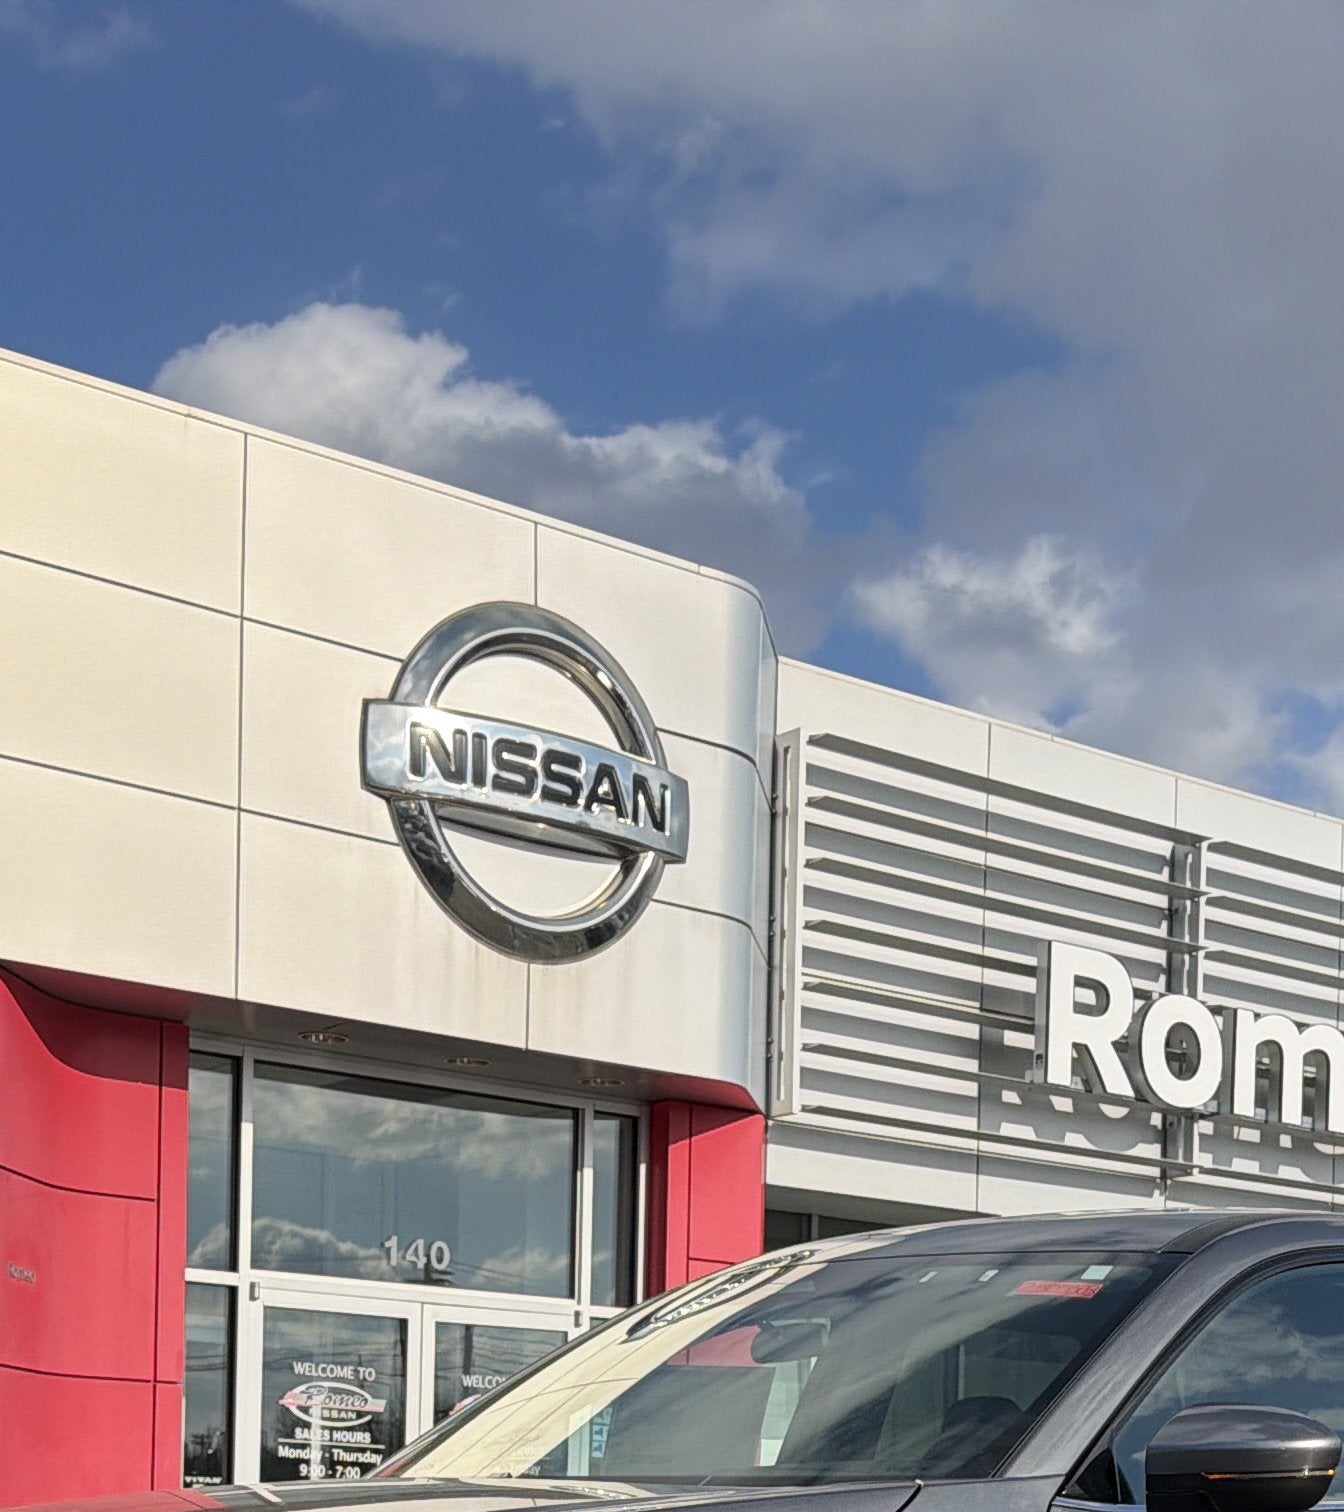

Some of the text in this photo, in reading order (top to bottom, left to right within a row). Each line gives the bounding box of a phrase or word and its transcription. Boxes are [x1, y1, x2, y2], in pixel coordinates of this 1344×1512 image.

[408, 720, 672, 836] NISSAN
[384, 1235, 451, 1270] 140
[293, 1361, 376, 1381] WELCOME TO
[461, 1374, 507, 1389] WELCO
[299, 1384, 369, 1408] Romeo
[309, 1409, 357, 1419] SSAN
[332, 1430, 372, 1444] HOURS
[331, 1448, 384, 1466] Thursday
[335, 1465, 361, 1480] 7:00
